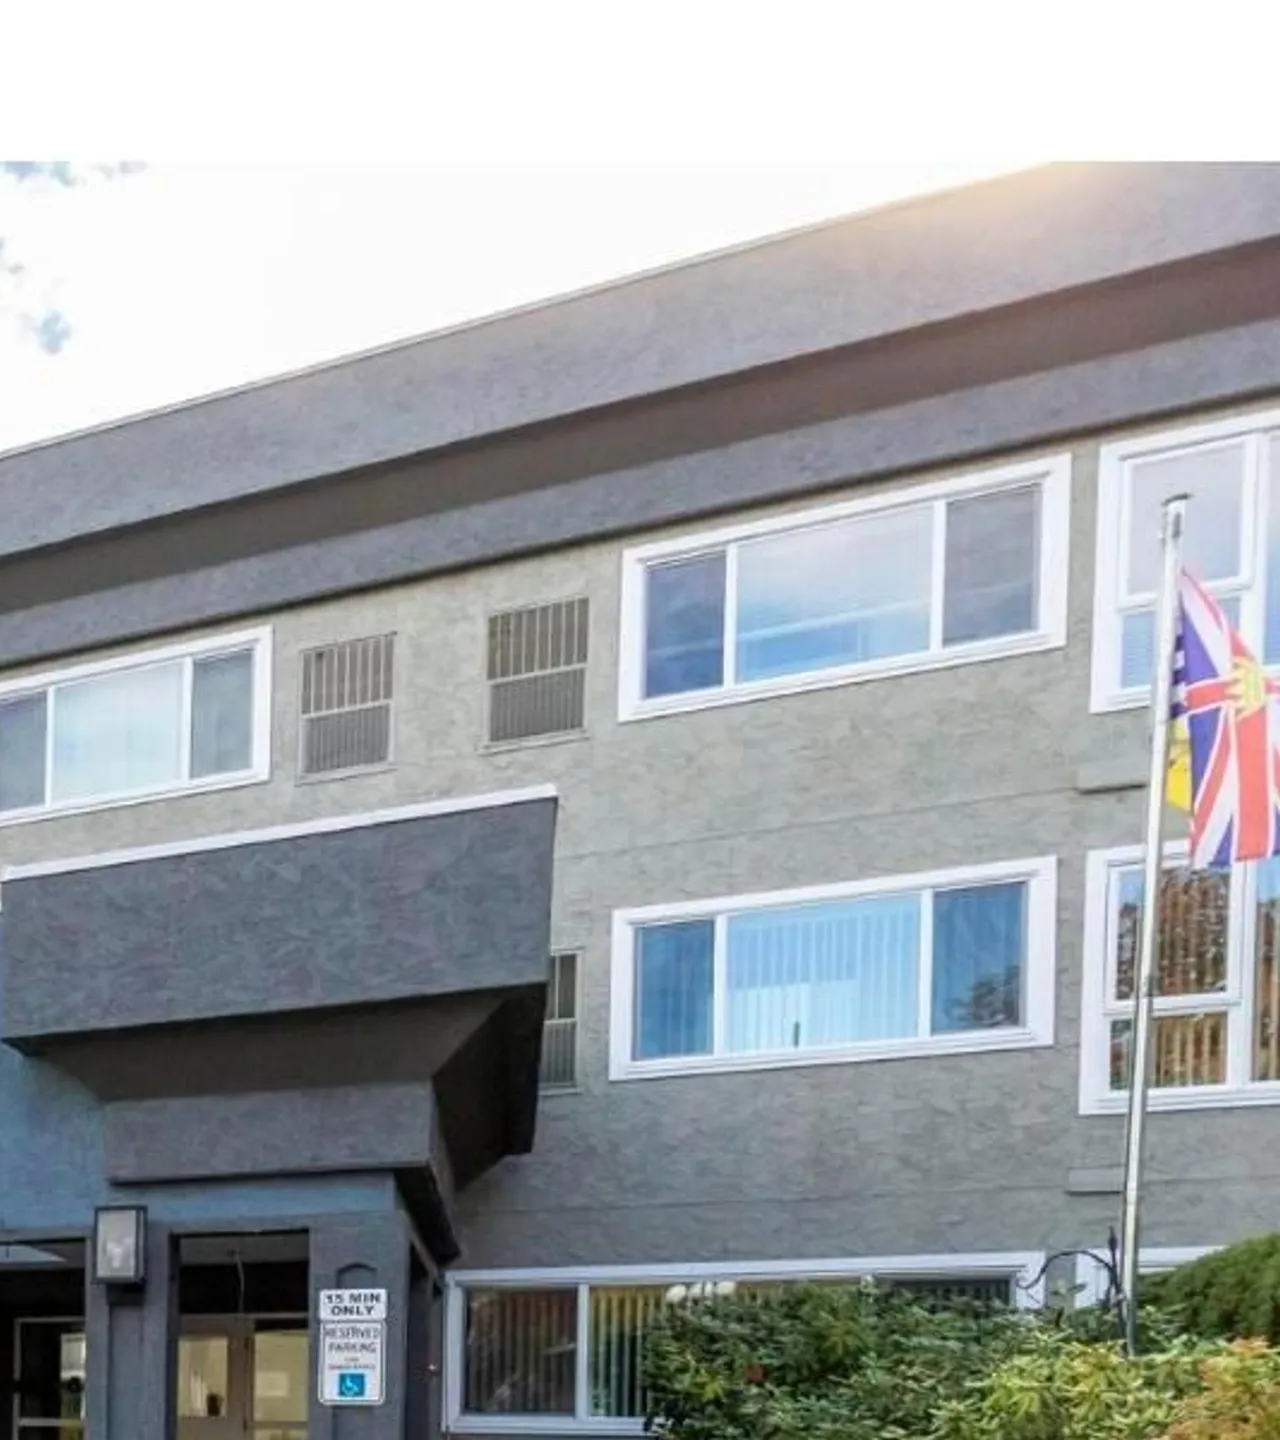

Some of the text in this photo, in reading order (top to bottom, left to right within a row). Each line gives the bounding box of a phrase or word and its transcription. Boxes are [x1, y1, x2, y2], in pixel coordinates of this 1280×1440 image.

[348, 1292, 381, 1303] MIN
[331, 1305, 374, 1316] ONLY
[324, 1327, 381, 1339] RESERVED
[328, 1341, 377, 1353] PARKING
